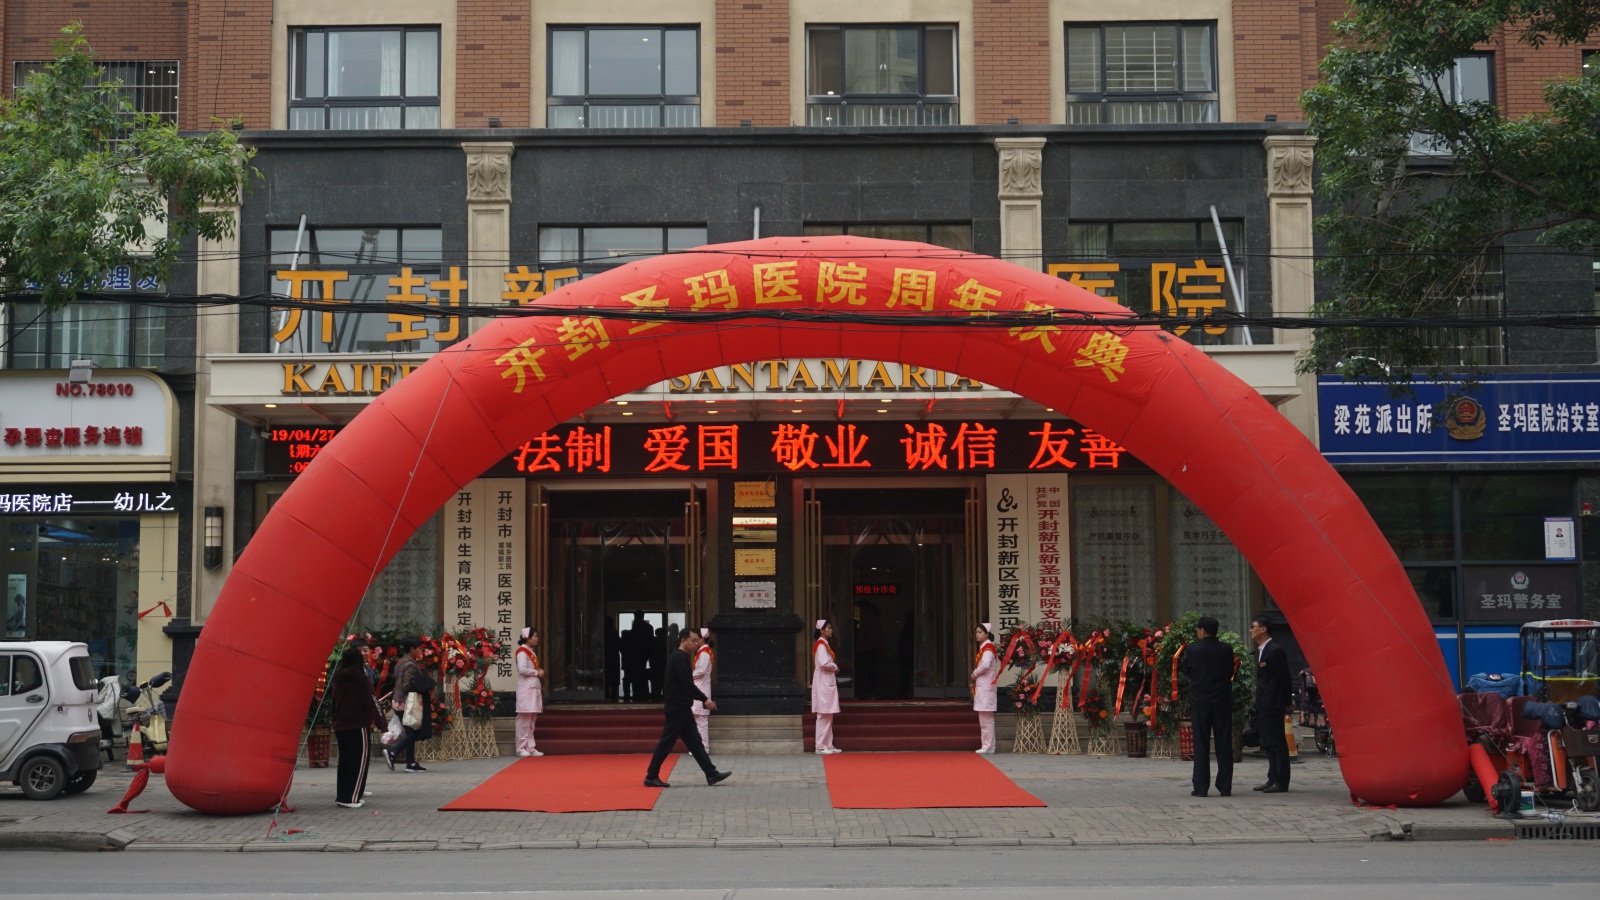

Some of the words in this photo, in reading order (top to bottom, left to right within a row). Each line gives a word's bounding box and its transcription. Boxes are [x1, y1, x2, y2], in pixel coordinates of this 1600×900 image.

[494, 260, 1129, 393] 开封圣玛医院周年庆典
[1334, 403, 1433, 435] 梁苑派出所
[1498, 402, 1600, 433] 圣玛医院治安室
[4, 425, 143, 447] 孕婴童服务连锁
[272, 428, 336, 442] 19/04/27
[514, 425, 612, 473] 法制
[643, 424, 739, 472] 爱国
[771, 423, 872, 471] 敬业
[900, 422, 998, 470] 诚信
[1028, 421, 1126, 469] 友善
[457, 492, 472, 635] 开封市生育保险定
[997, 517, 1020, 640] 开封新区新圣玛
[855, 585, 897, 594] 预检分诊处
[1481, 593, 1562, 609] 圣玛警务室
